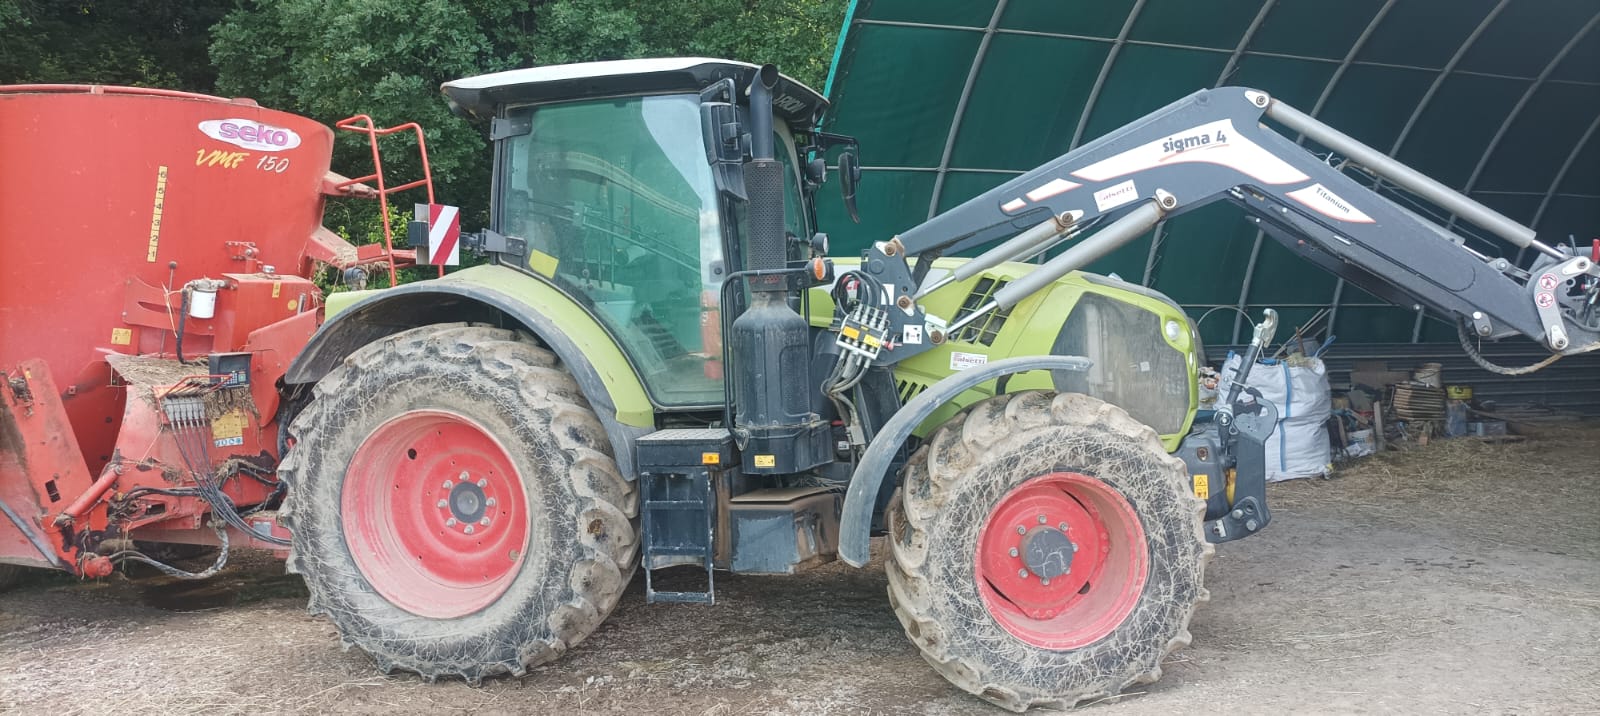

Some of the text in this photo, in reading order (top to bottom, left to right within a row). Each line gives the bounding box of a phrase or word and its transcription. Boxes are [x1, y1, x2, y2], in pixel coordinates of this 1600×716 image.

[219, 122, 289, 146] seko
[1162, 130, 1227, 153] sigma 4
[196, 148, 290, 174] VMF 150
[1316, 187, 1350, 214] Titanium
